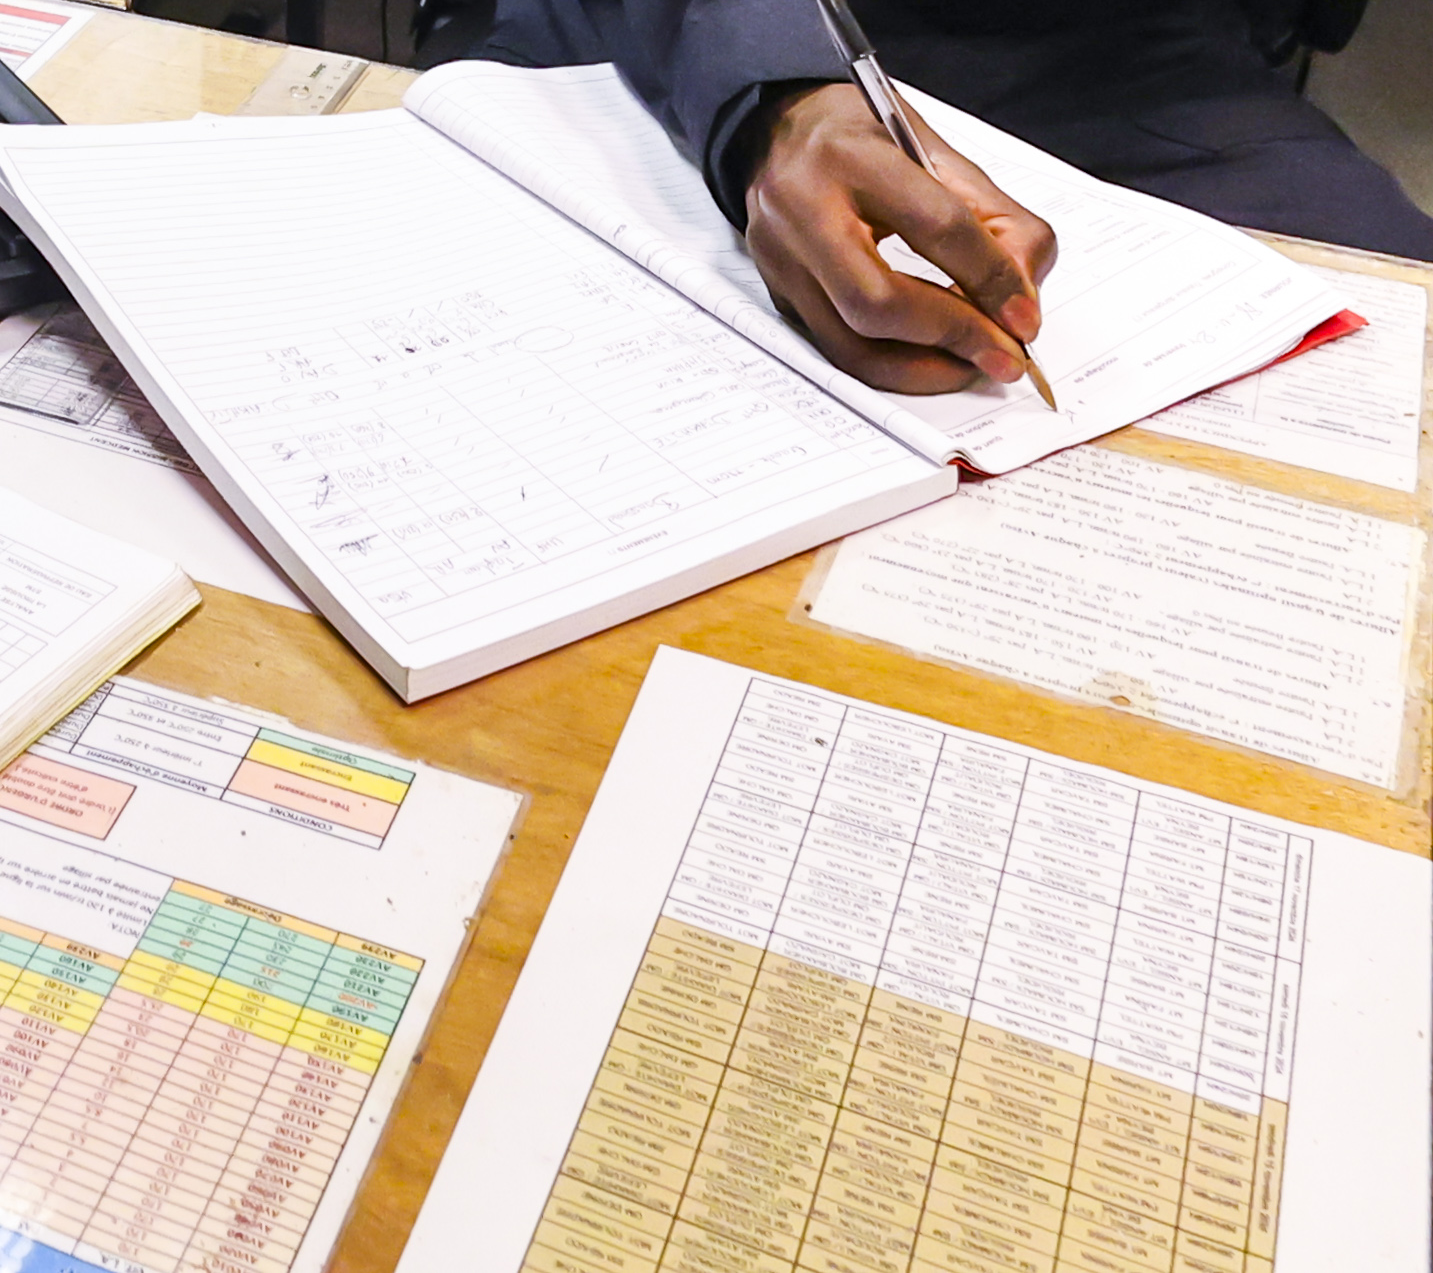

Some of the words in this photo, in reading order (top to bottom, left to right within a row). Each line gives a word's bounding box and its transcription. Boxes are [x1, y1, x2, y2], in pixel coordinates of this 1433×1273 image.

[84, 745, 161, 778] d'échappement
[298, 757, 354, 783] Encrassant
[161, 770, 209, 793] Moyenne
[271, 780, 331, 807] encrassant
[47, 799, 84, 818] ORDRE
[329, 798, 352, 813] Très
[266, 804, 335, 834] CONDITIONS
[105, 888, 140, 909] jamais
